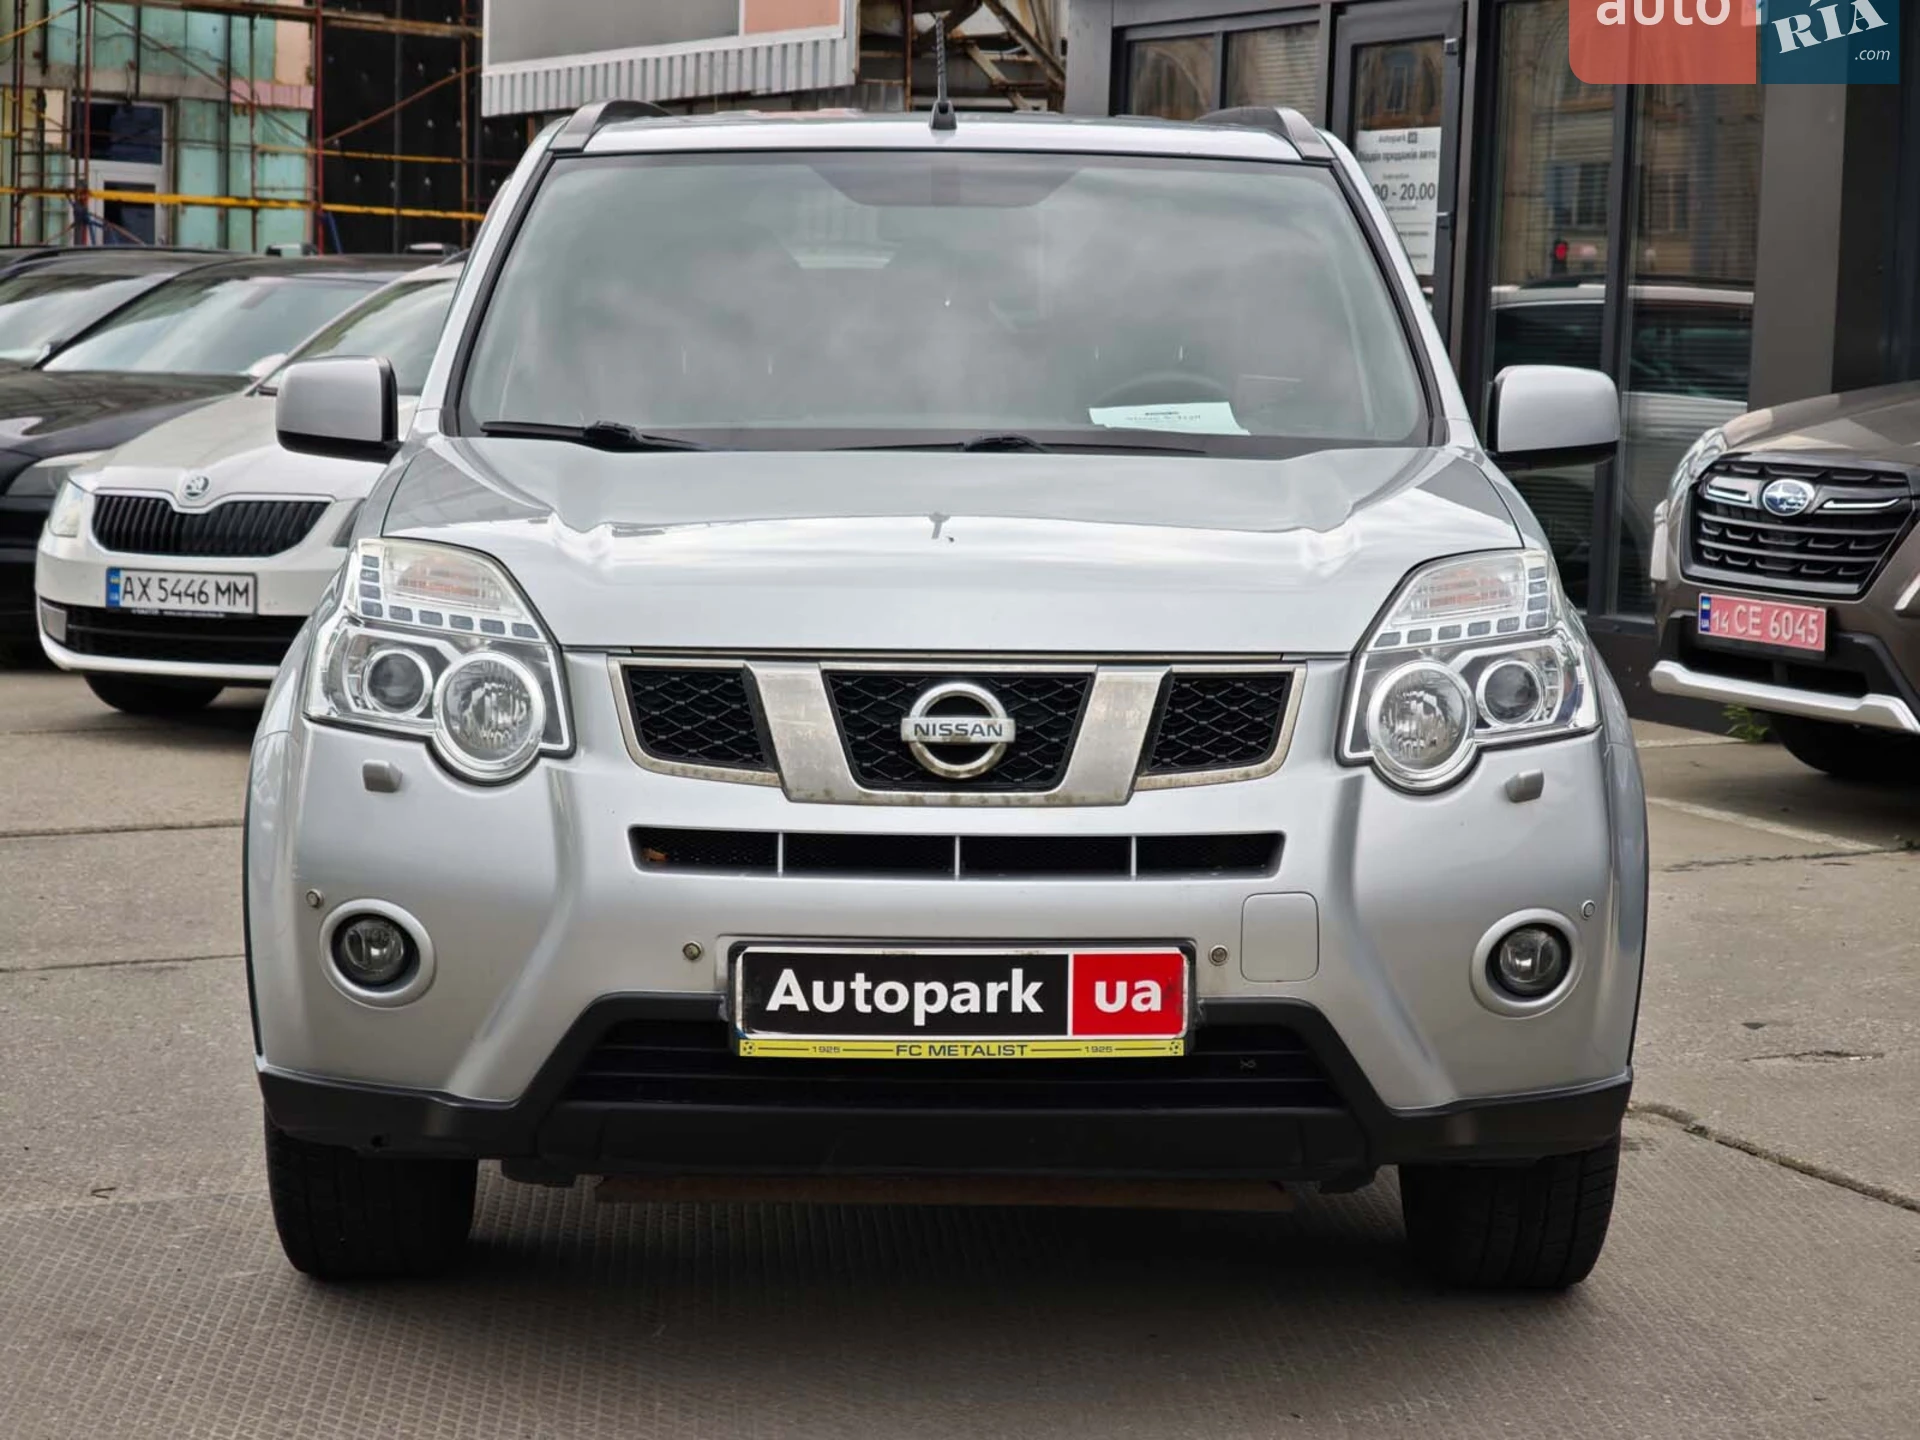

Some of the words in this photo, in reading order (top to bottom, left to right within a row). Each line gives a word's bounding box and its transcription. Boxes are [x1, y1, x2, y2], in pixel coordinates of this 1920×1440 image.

[1400, 181, 1436, 201] 20.00
[122, 576, 152, 602] AX
[157, 577, 210, 605] 5446
[214, 580, 250, 608] MM
[1768, 608, 1820, 645] 6045
[913, 722, 1003, 738] NISSAN
[765, 967, 1044, 1027] Autopark
[1093, 978, 1163, 1013] ua
[895, 1044, 923, 1057] FC
[927, 1044, 1028, 1057] METALIST
